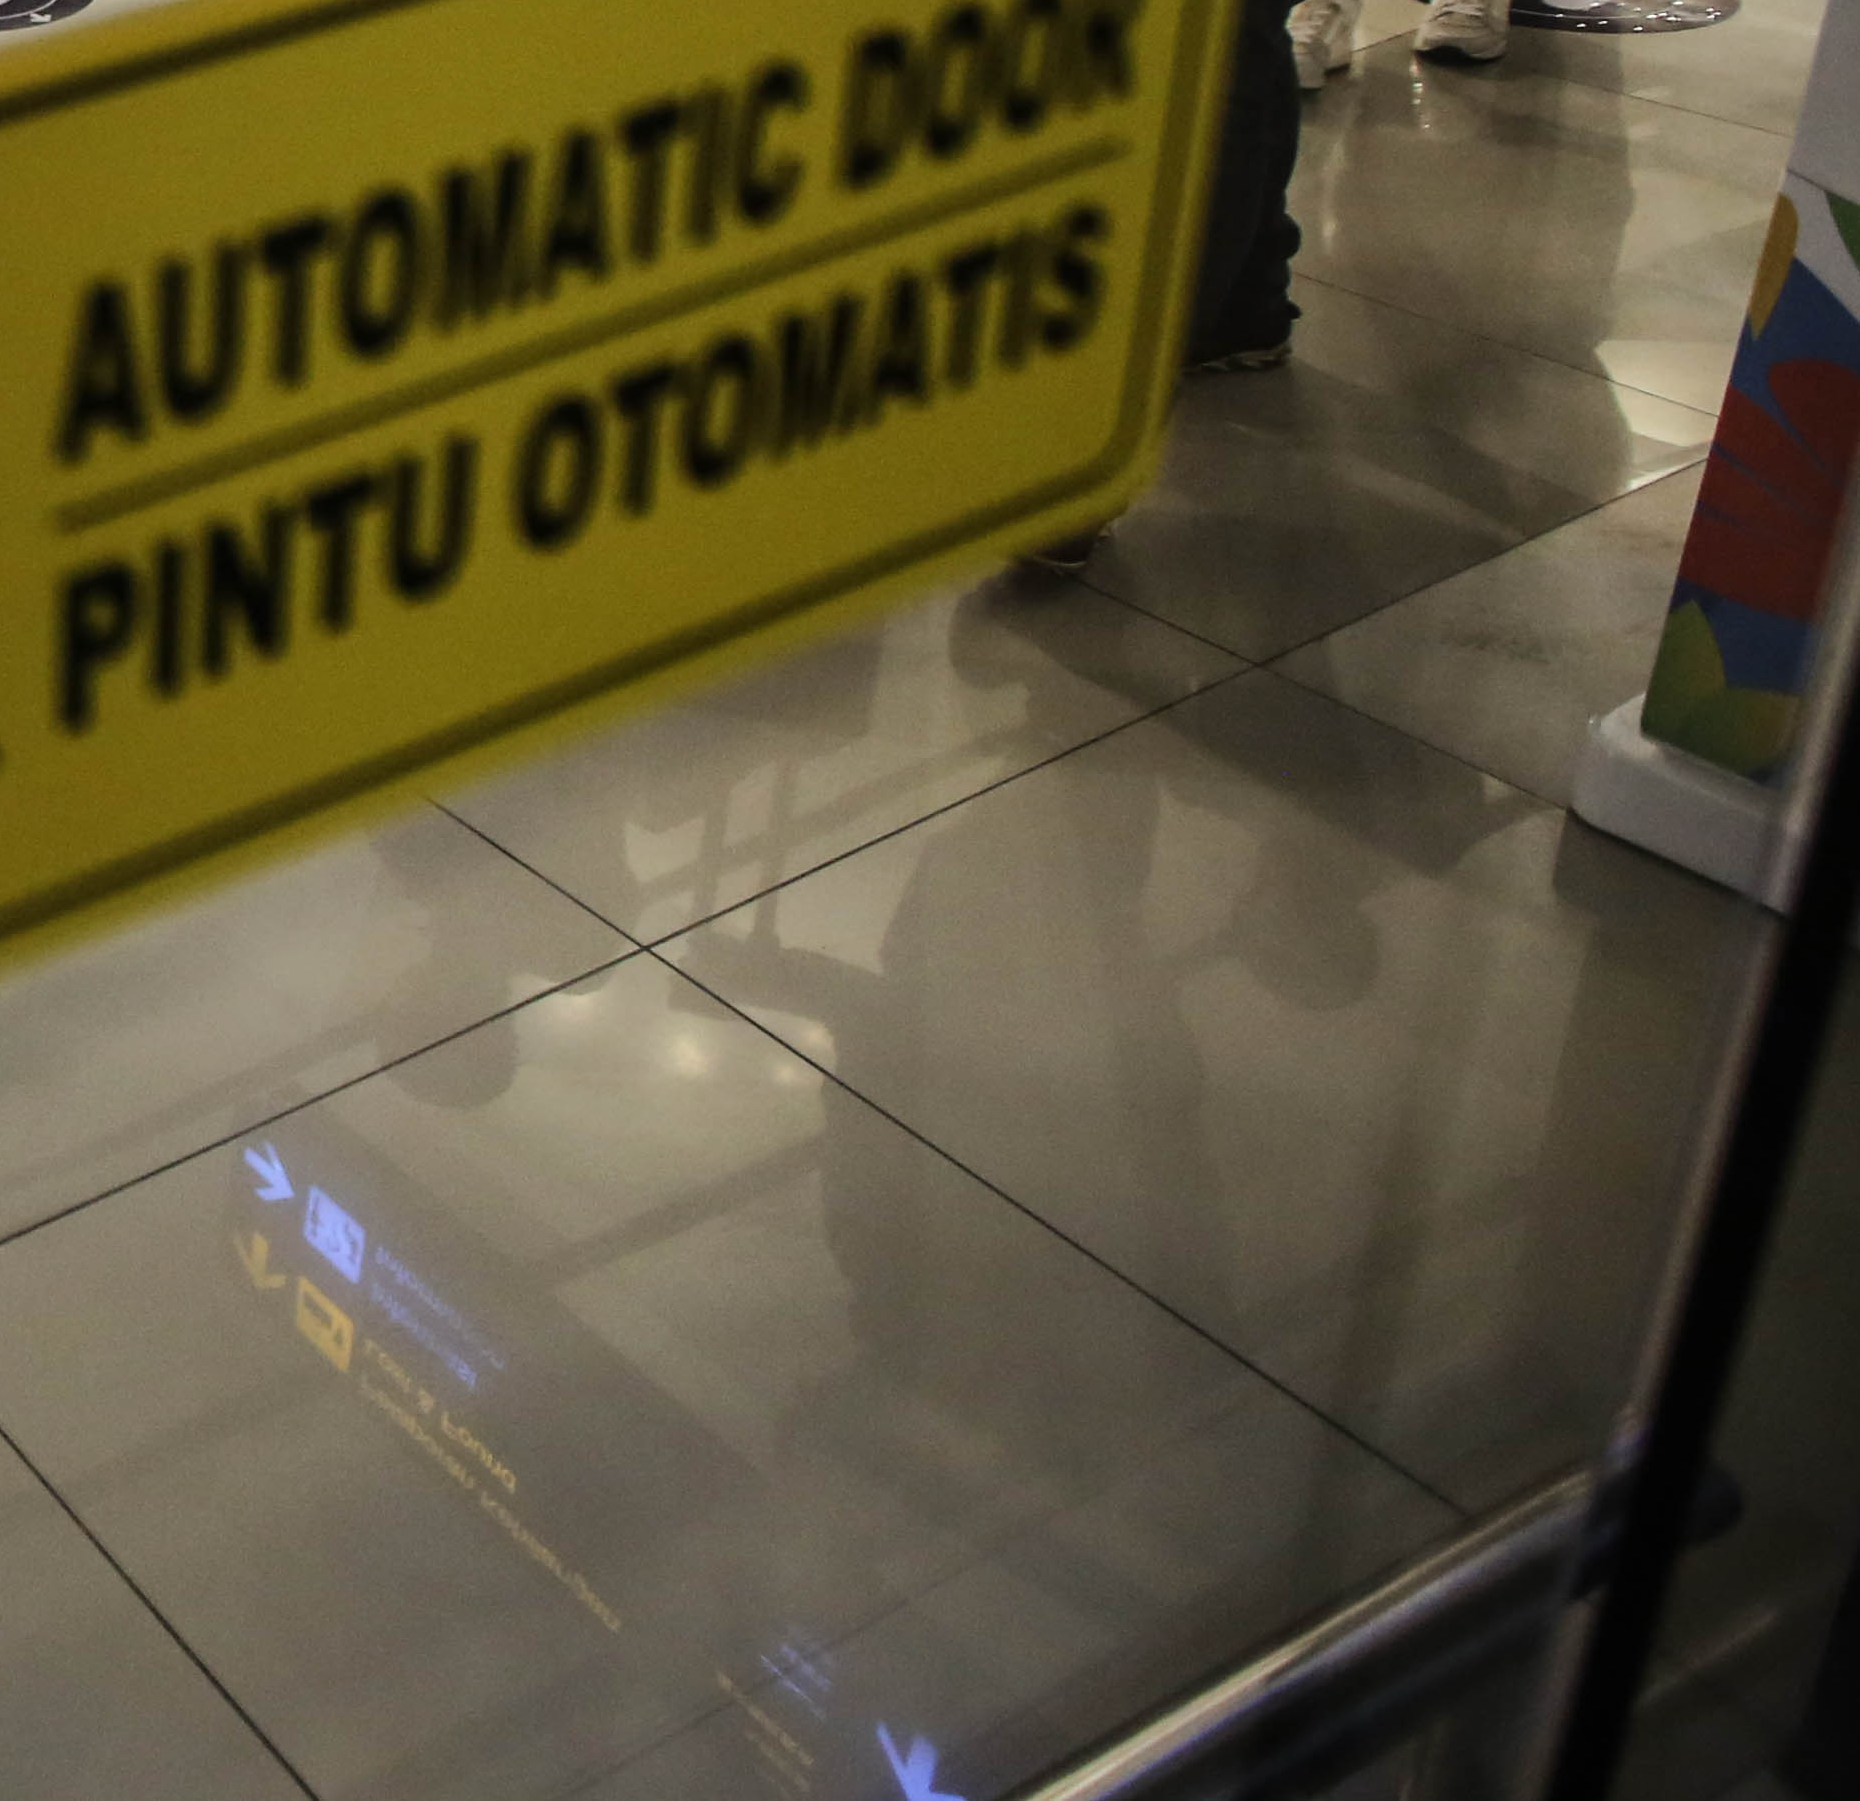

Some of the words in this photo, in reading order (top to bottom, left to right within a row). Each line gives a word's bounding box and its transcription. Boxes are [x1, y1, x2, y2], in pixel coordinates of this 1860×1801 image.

[57, 66, 807, 462] AUTOMATIC
[57, 430, 474, 730] PINTU
[515, 208, 1109, 550] OTOMATIS
